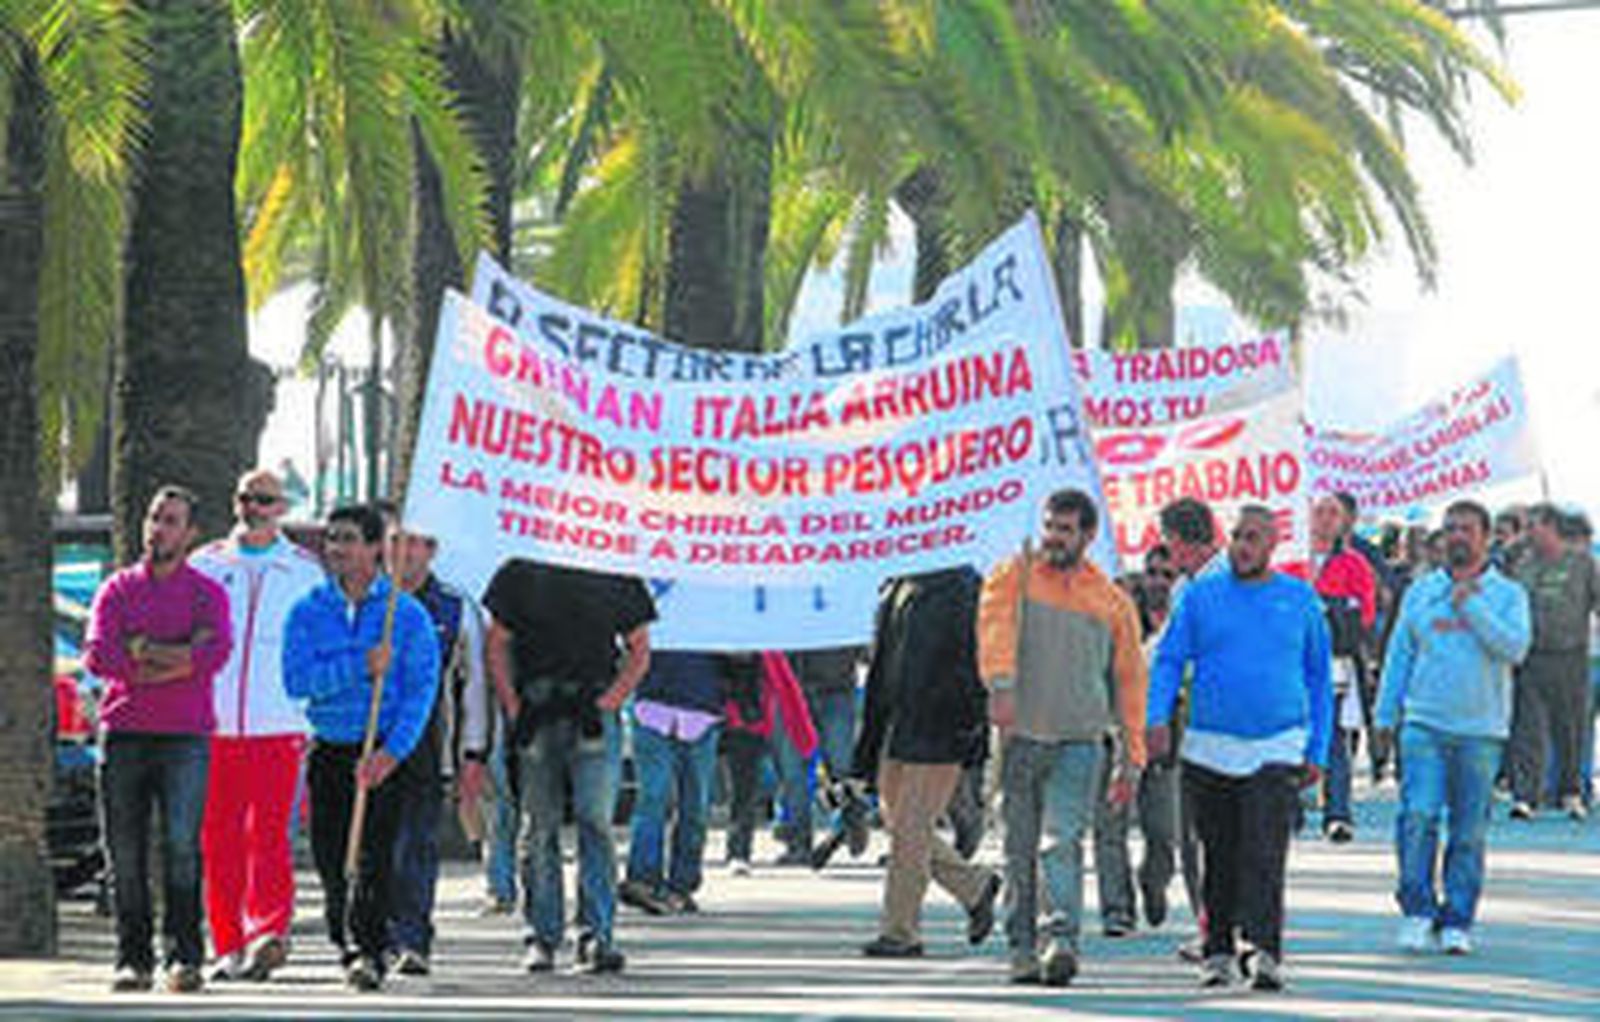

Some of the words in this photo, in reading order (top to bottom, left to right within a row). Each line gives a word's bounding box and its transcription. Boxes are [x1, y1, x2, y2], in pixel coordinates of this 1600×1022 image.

[812, 333, 873, 377] LA
[1112, 336, 1281, 384] TRAIDORA
[693, 391, 829, 442] ITALIA
[840, 346, 1034, 427] ARRUINA
[1163, 394, 1206, 422] TU
[447, 392, 637, 485] NUESTRO
[648, 446, 809, 497] SECTOR
[823, 415, 1034, 497] PESQUERO
[440, 461, 488, 495] LA
[500, 478, 628, 526] MEJOR
[638, 508, 787, 537] CHIRLA
[799, 511, 873, 536] DEL
[885, 479, 1024, 530] MUNDO
[1131, 451, 1300, 507] TRABAJO
[497, 509, 642, 556] TIENDE
[649, 538, 679, 562] A
[688, 524, 976, 565] DESAPARECER.
